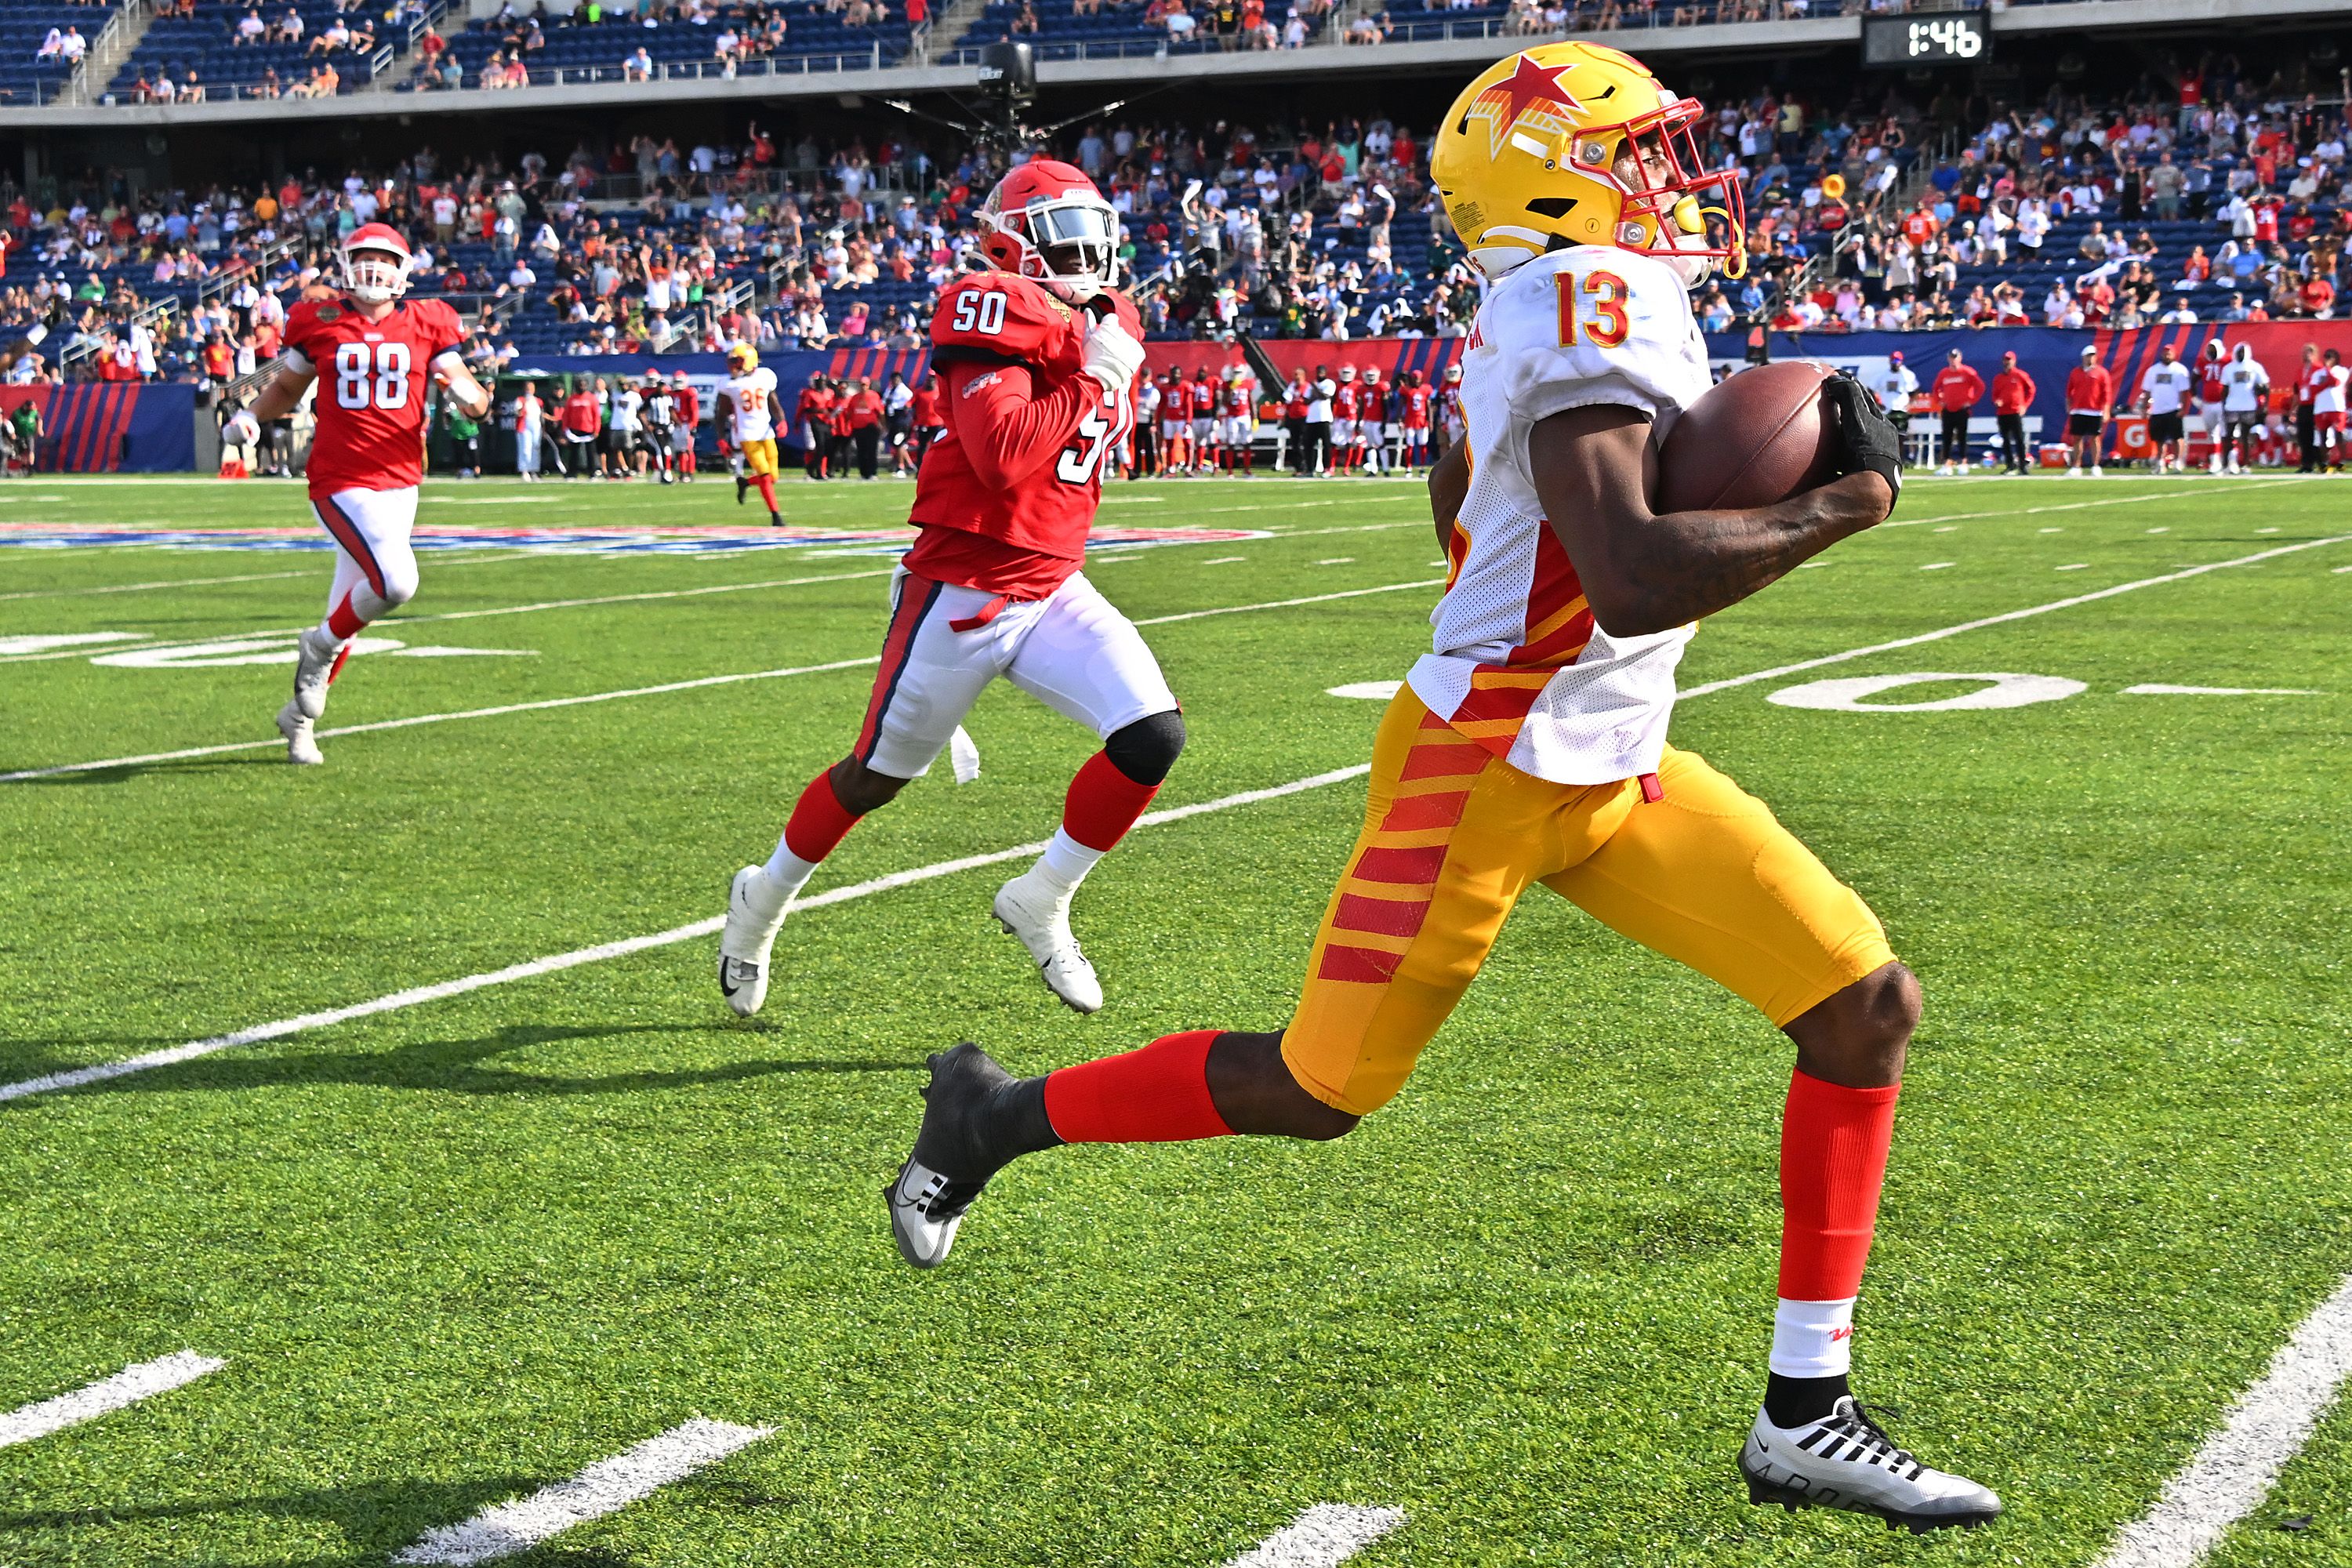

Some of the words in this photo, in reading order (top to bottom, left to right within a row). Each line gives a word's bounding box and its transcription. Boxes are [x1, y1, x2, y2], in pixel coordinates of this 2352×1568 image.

[1909, 20, 1982, 58] 1:46
[952, 290, 1007, 335] 50
[1553, 270, 1629, 348] 13
[336, 342, 411, 409] 88
[2124, 424, 2147, 448] G
